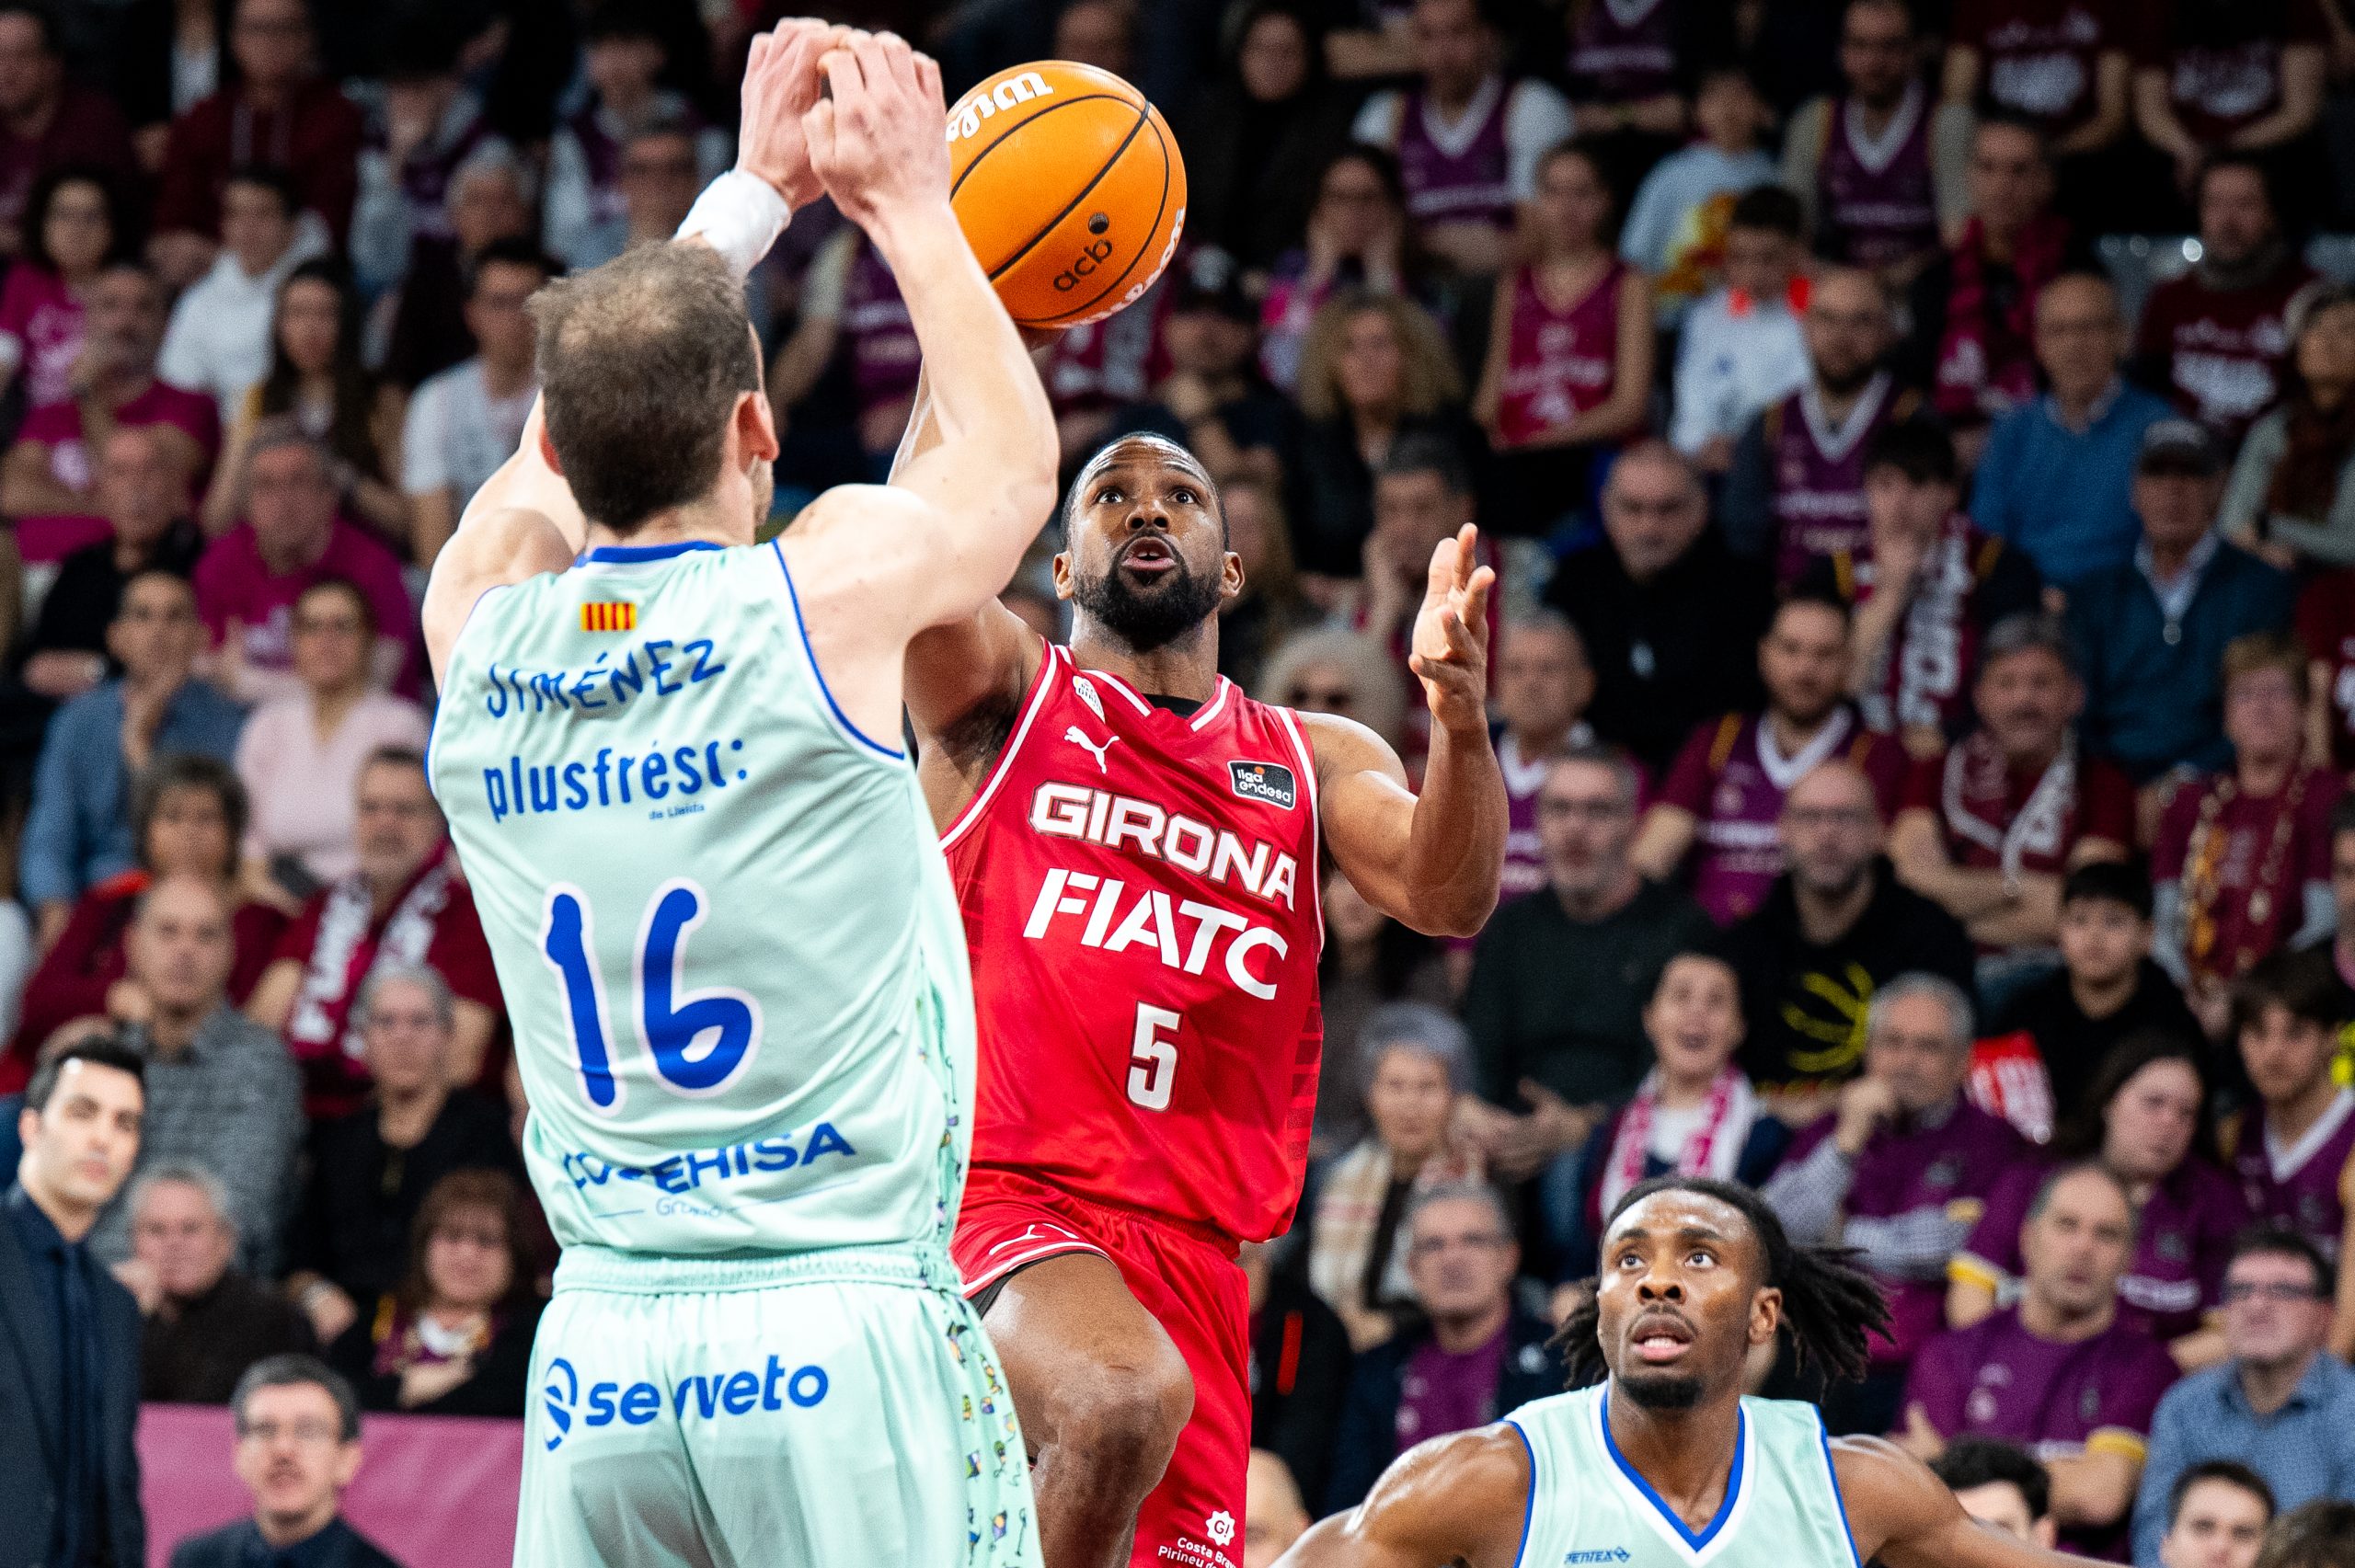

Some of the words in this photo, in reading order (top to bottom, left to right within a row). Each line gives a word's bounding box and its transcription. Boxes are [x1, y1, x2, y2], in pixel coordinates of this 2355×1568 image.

[945, 72, 1055, 143] Wils
[1052, 239, 1113, 292] acb
[488, 638, 726, 718] JIMÉNEZ
[1236, 769, 1264, 784] liga
[1239, 781, 1292, 803] endesa
[1028, 781, 1299, 913] GIRONA
[1022, 867, 1289, 1001] FIATC
[541, 881, 759, 1111] 16
[1124, 999, 1185, 1112] 5
[584, 1355, 829, 1426] serveto
[1157, 1545, 1205, 1568] Pirineu
[1177, 1537, 1213, 1559] Costa
[1214, 1551, 1238, 1568] Brav
